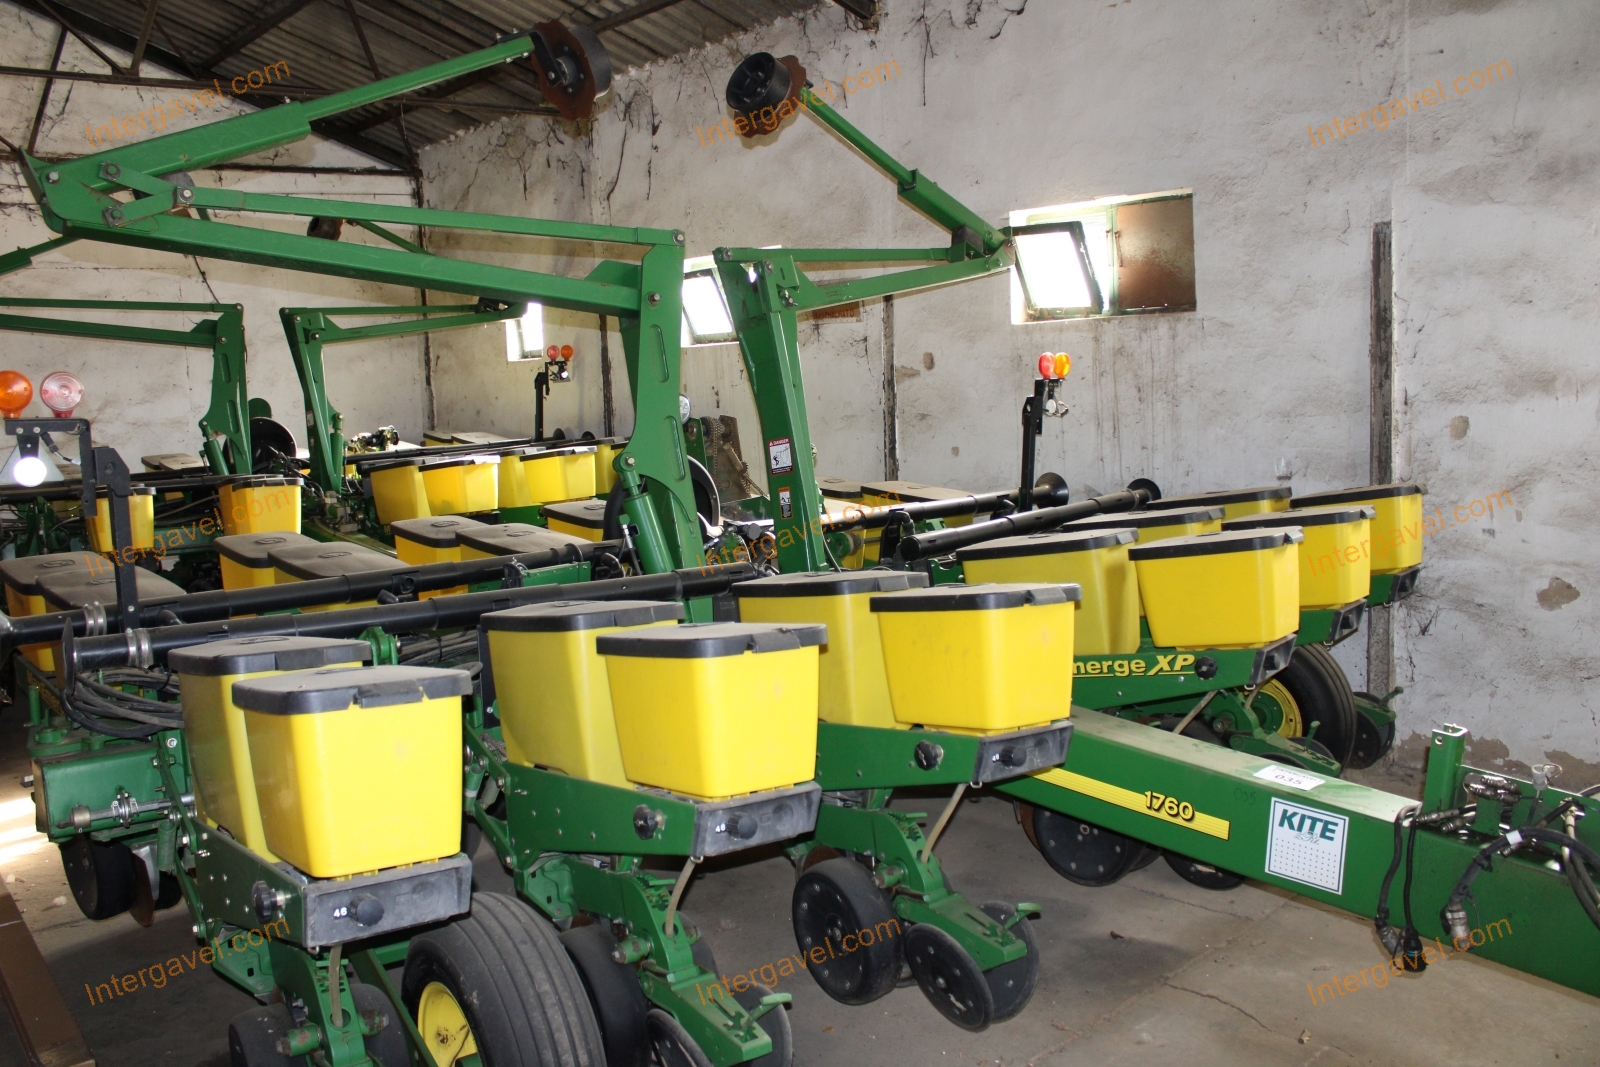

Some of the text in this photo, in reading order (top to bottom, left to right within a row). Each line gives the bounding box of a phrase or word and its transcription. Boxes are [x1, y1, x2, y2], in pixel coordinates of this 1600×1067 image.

[1146, 654, 1195, 676] XP
[1274, 774, 1303, 785] 035
[1144, 790, 1195, 821] 1760
[1278, 808, 1339, 842] KITE
[333, 906, 348, 918] 46
